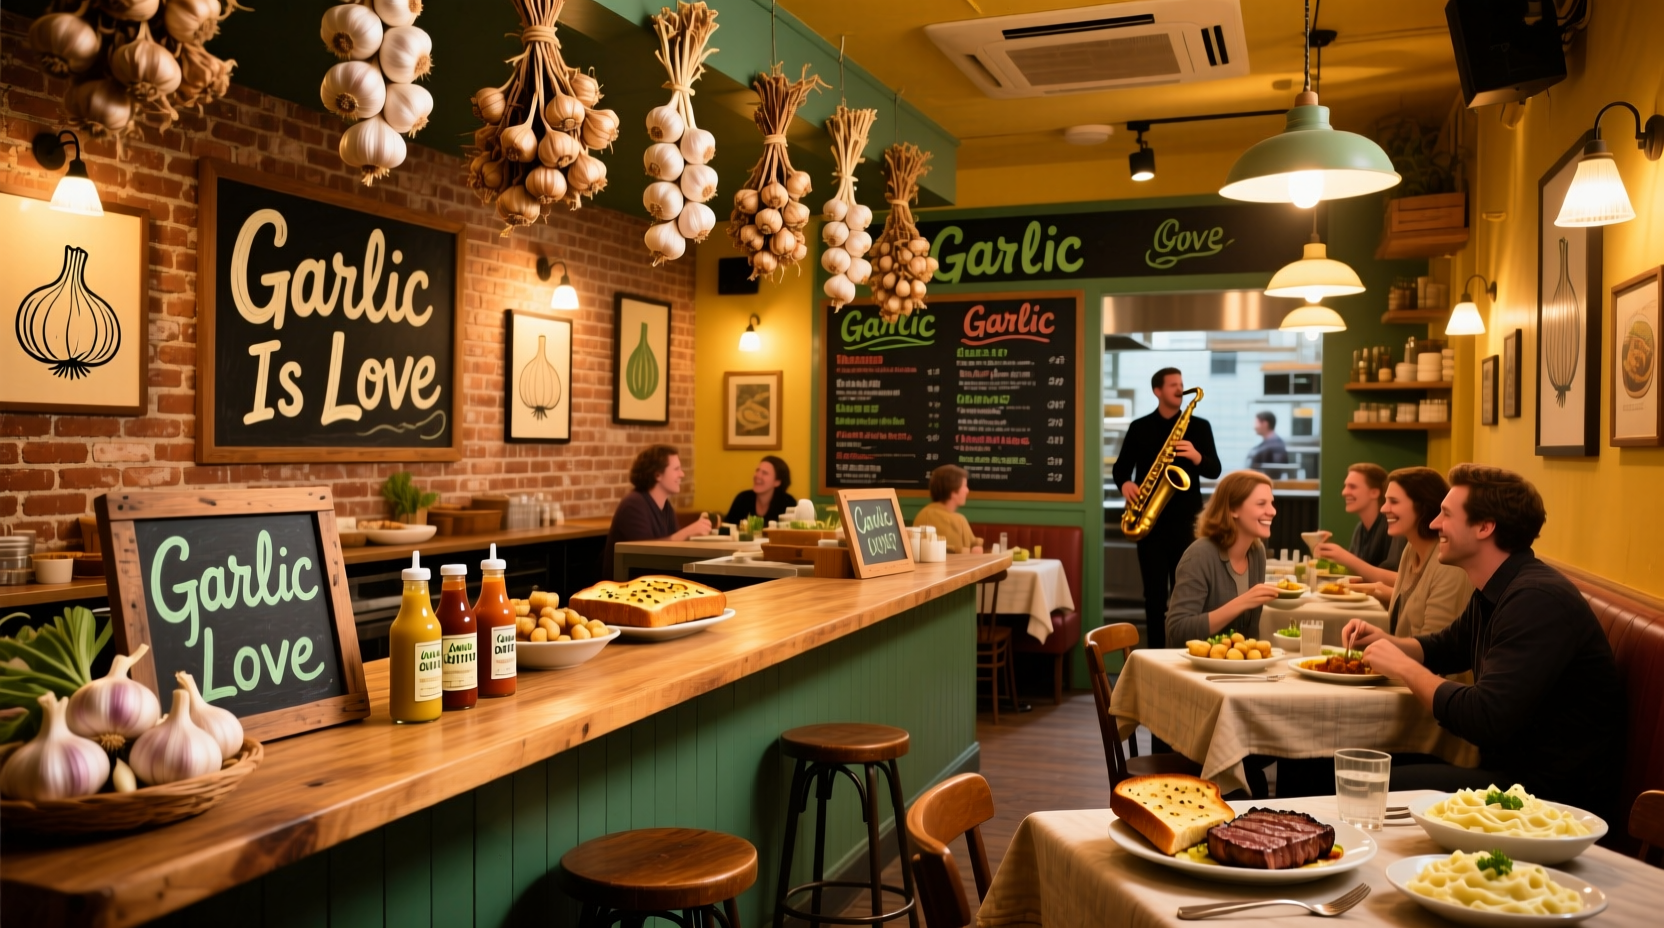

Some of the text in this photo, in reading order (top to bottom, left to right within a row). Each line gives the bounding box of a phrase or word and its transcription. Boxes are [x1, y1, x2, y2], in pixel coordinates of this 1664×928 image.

[230, 208, 433, 330] Garlic
[930, 220, 1085, 284] Garlic
[963, 302, 1055, 338] Garlic
[243, 331, 442, 427] Is Love
[150, 529, 319, 648] Garlic
[202, 627, 325, 703] Love
